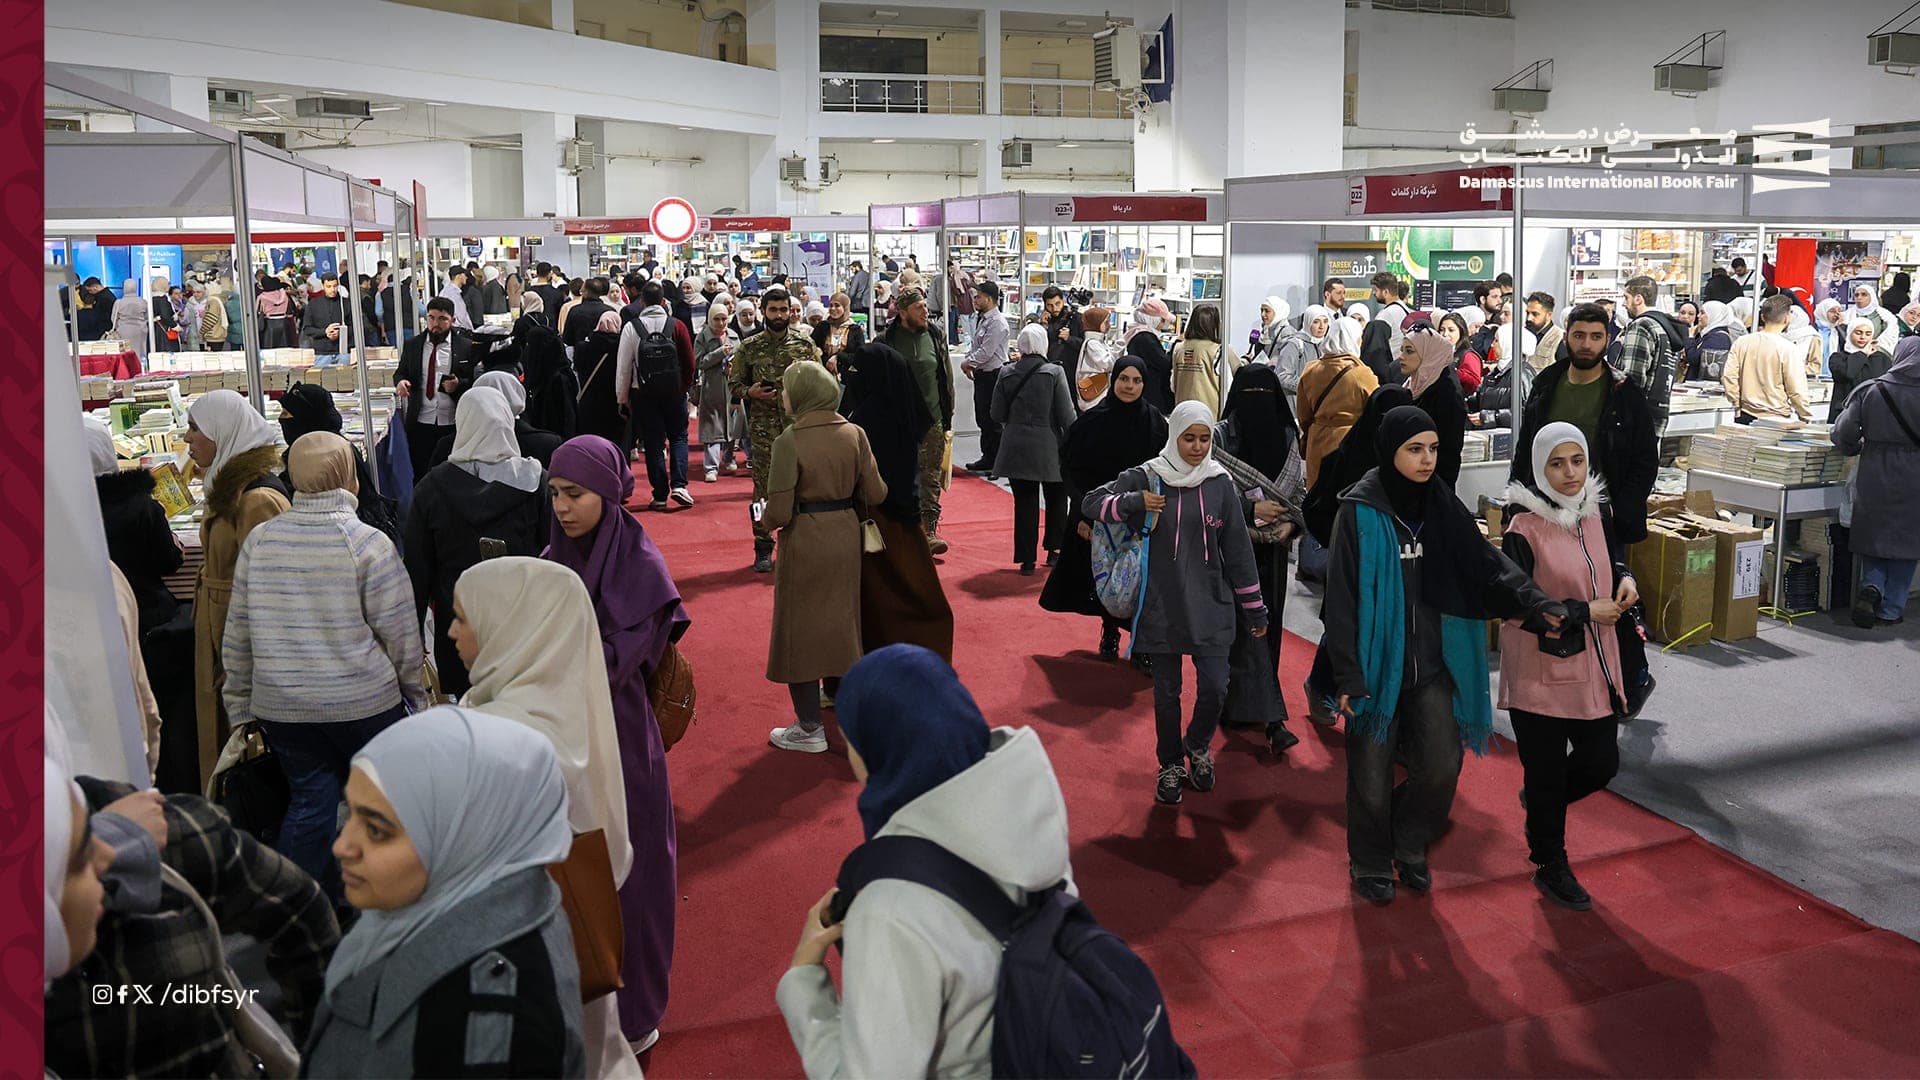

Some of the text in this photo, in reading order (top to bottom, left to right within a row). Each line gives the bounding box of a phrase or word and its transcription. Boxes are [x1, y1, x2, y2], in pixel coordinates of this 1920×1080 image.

[1391, 184, 1437, 200] شركة دار كلمات
